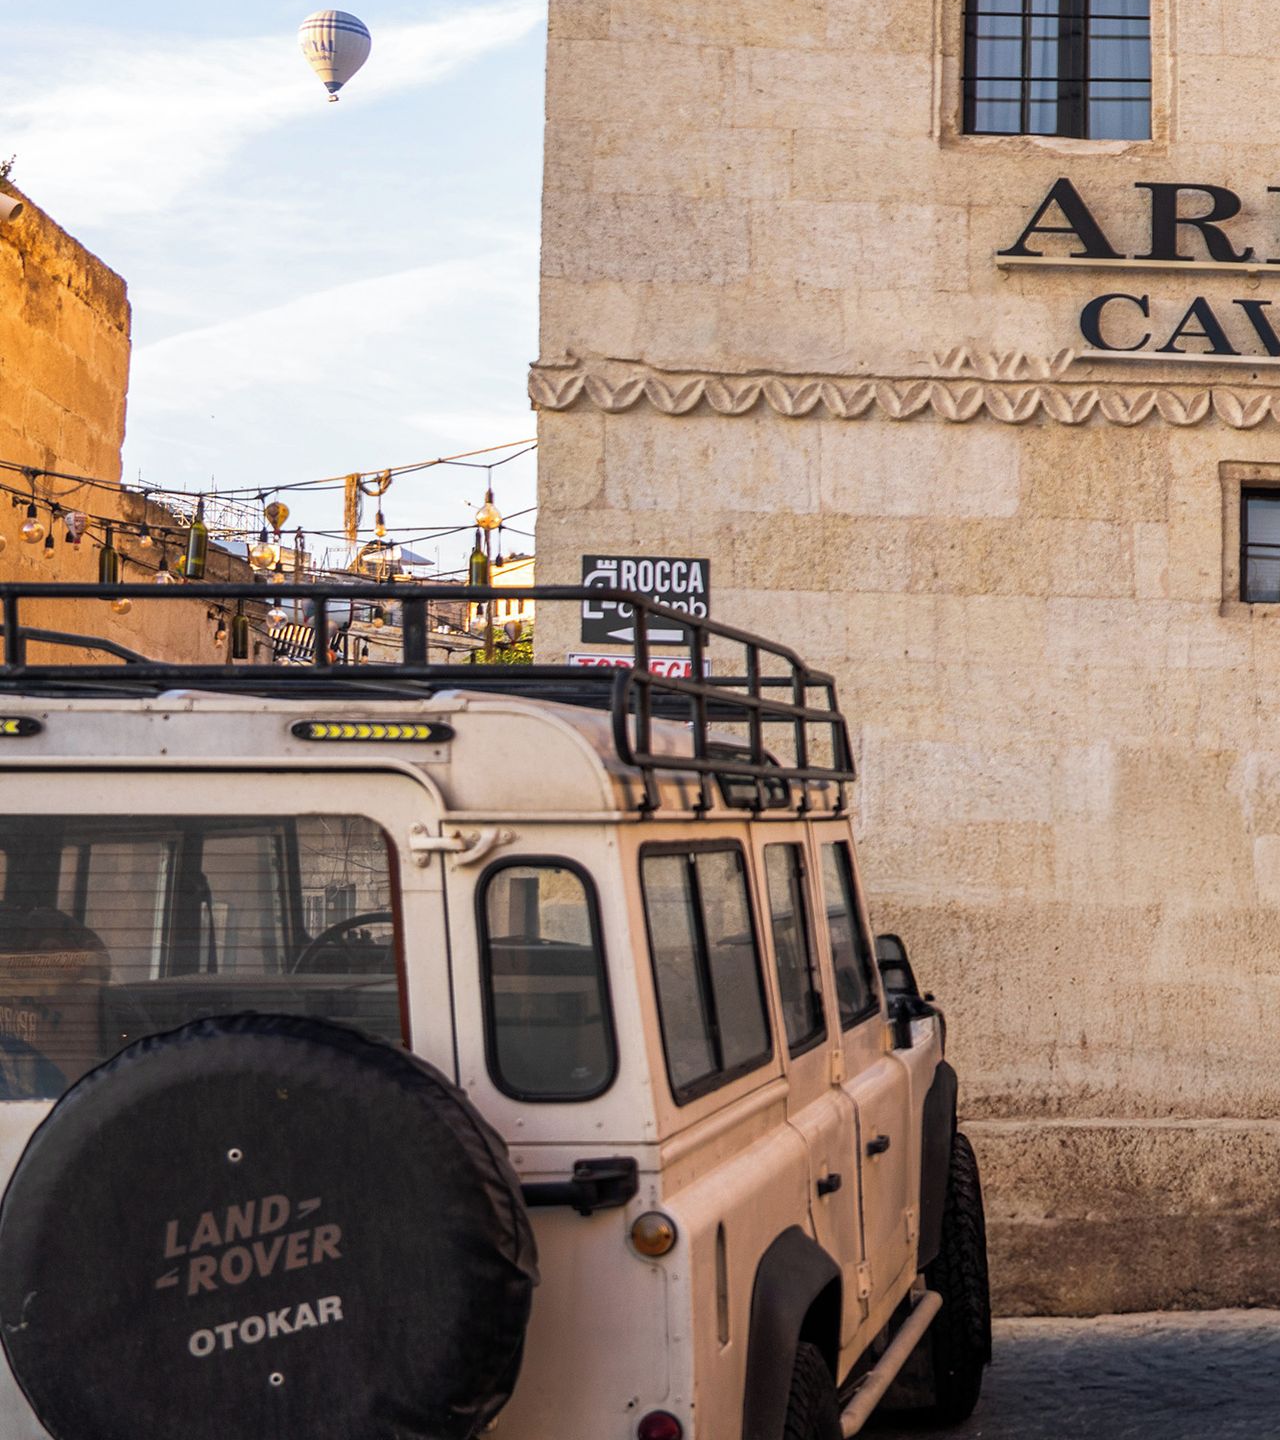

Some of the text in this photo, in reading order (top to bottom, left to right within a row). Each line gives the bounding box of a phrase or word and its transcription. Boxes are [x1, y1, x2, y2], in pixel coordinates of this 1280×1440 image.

[621, 560, 704, 593] ROCCA
[163, 1193, 291, 1258] LAND
[187, 1223, 342, 1296] ROVER
[188, 1295, 344, 1357] OTOKAR
